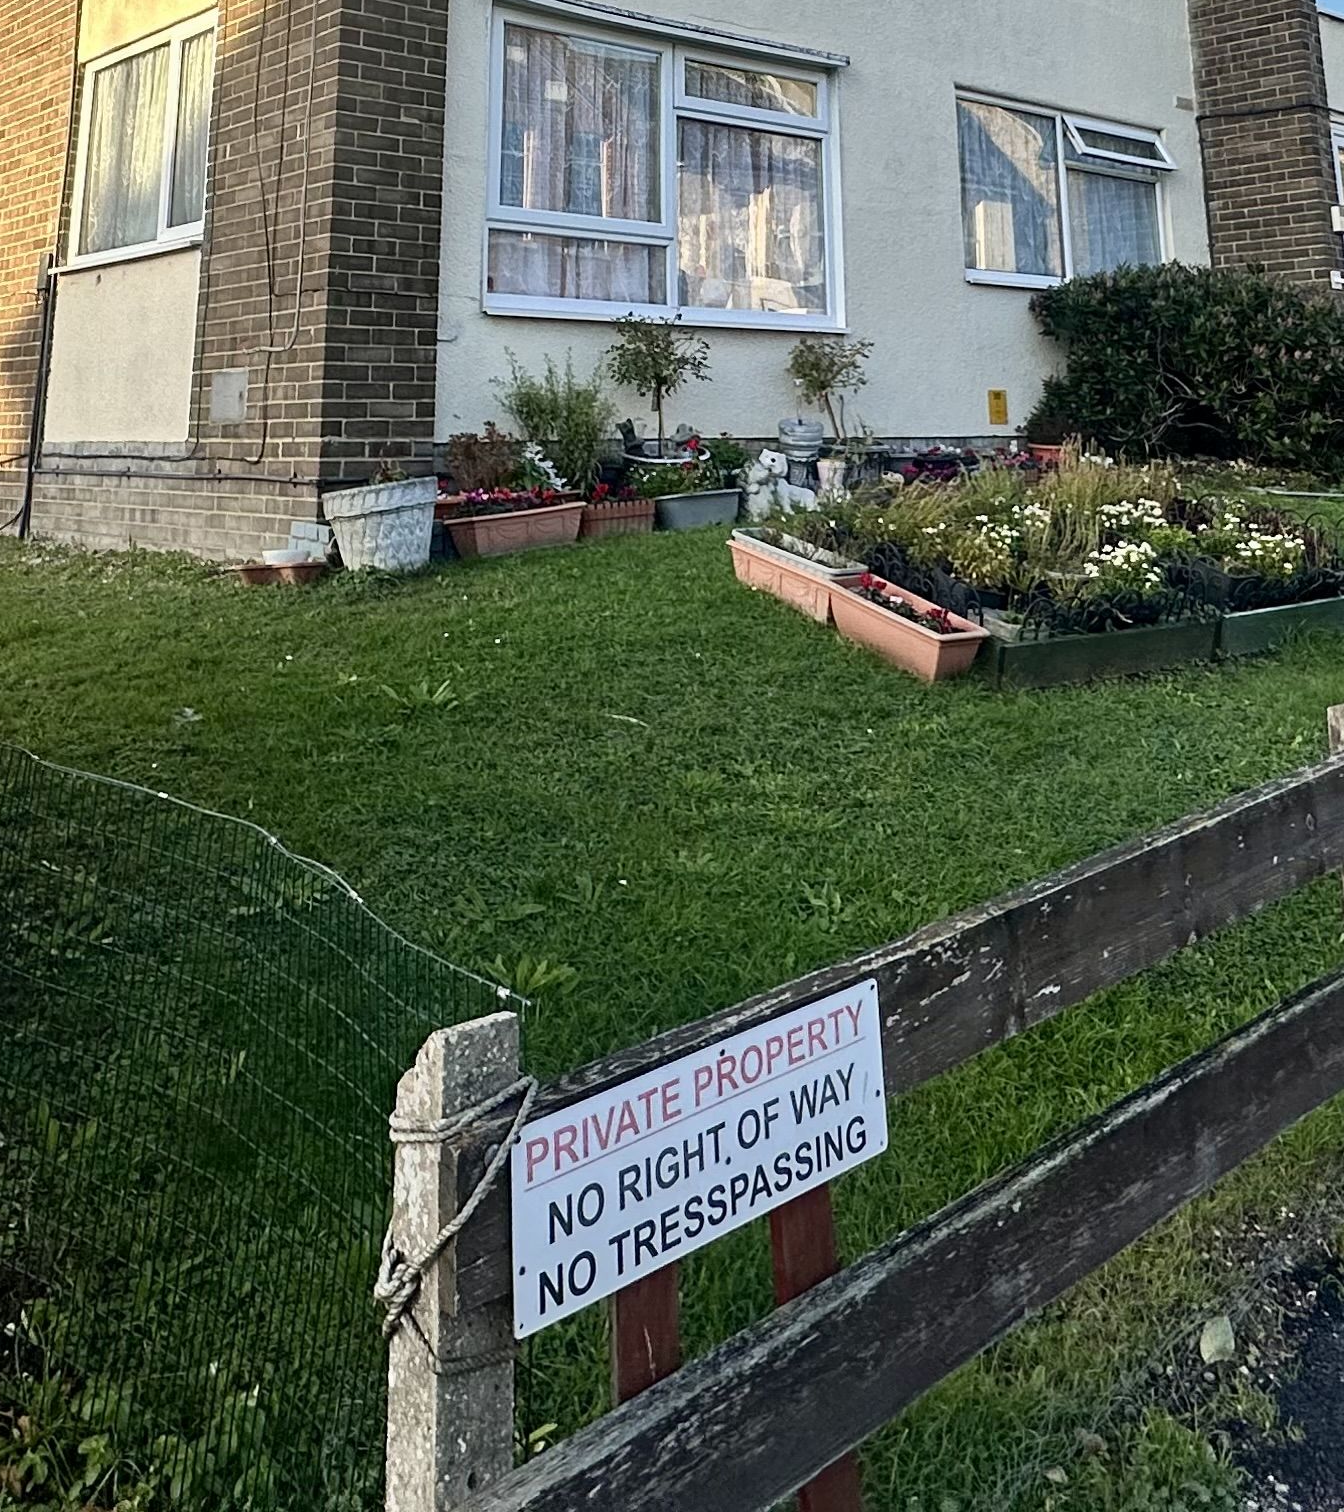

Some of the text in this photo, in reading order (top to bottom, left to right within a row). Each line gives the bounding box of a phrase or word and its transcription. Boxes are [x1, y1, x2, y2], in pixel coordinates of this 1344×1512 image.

[525, 999, 864, 1183] PRIVATE PROPERTY
[548, 1062, 856, 1245] NO RIGHT OF WAY
[538, 1115, 867, 1316] NO TRESSPASSING
